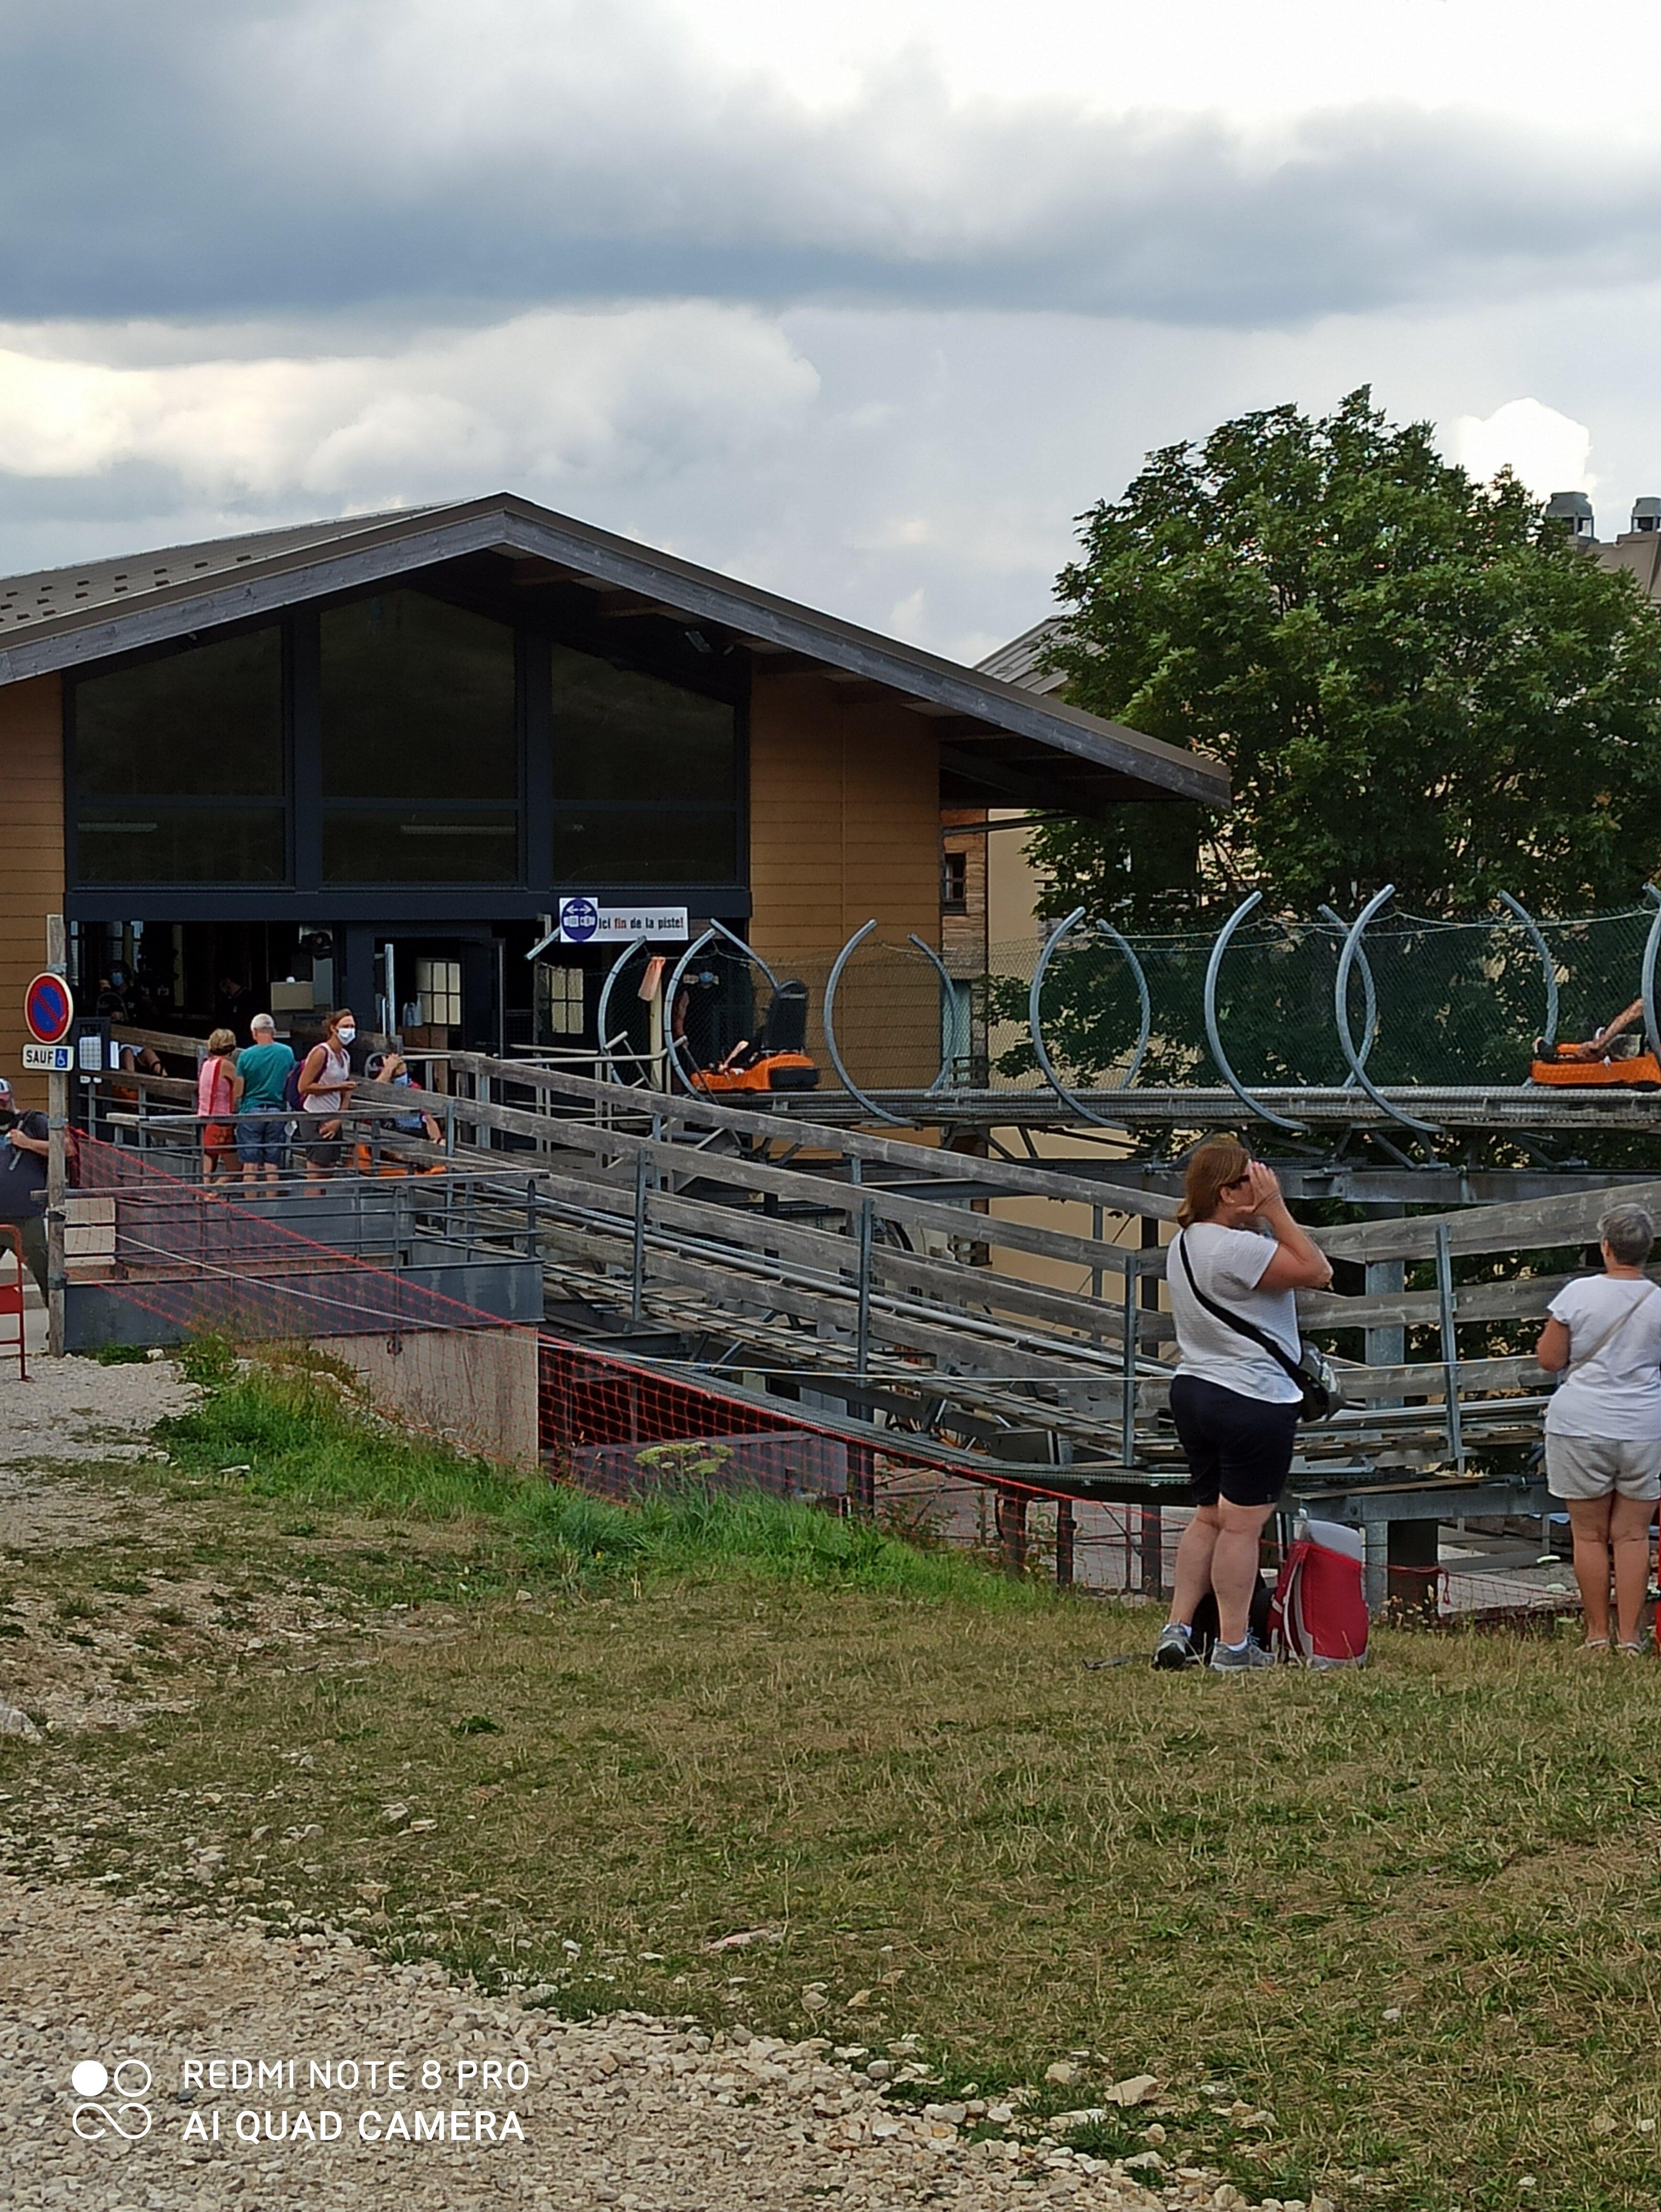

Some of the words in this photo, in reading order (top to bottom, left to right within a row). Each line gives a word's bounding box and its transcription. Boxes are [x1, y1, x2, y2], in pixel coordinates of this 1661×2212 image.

[614, 917, 627, 929] fin
[630, 917, 642, 929] de
[646, 917, 654, 929] la
[658, 916, 684, 930] piste!
[26, 1050, 54, 1064] SAUF
